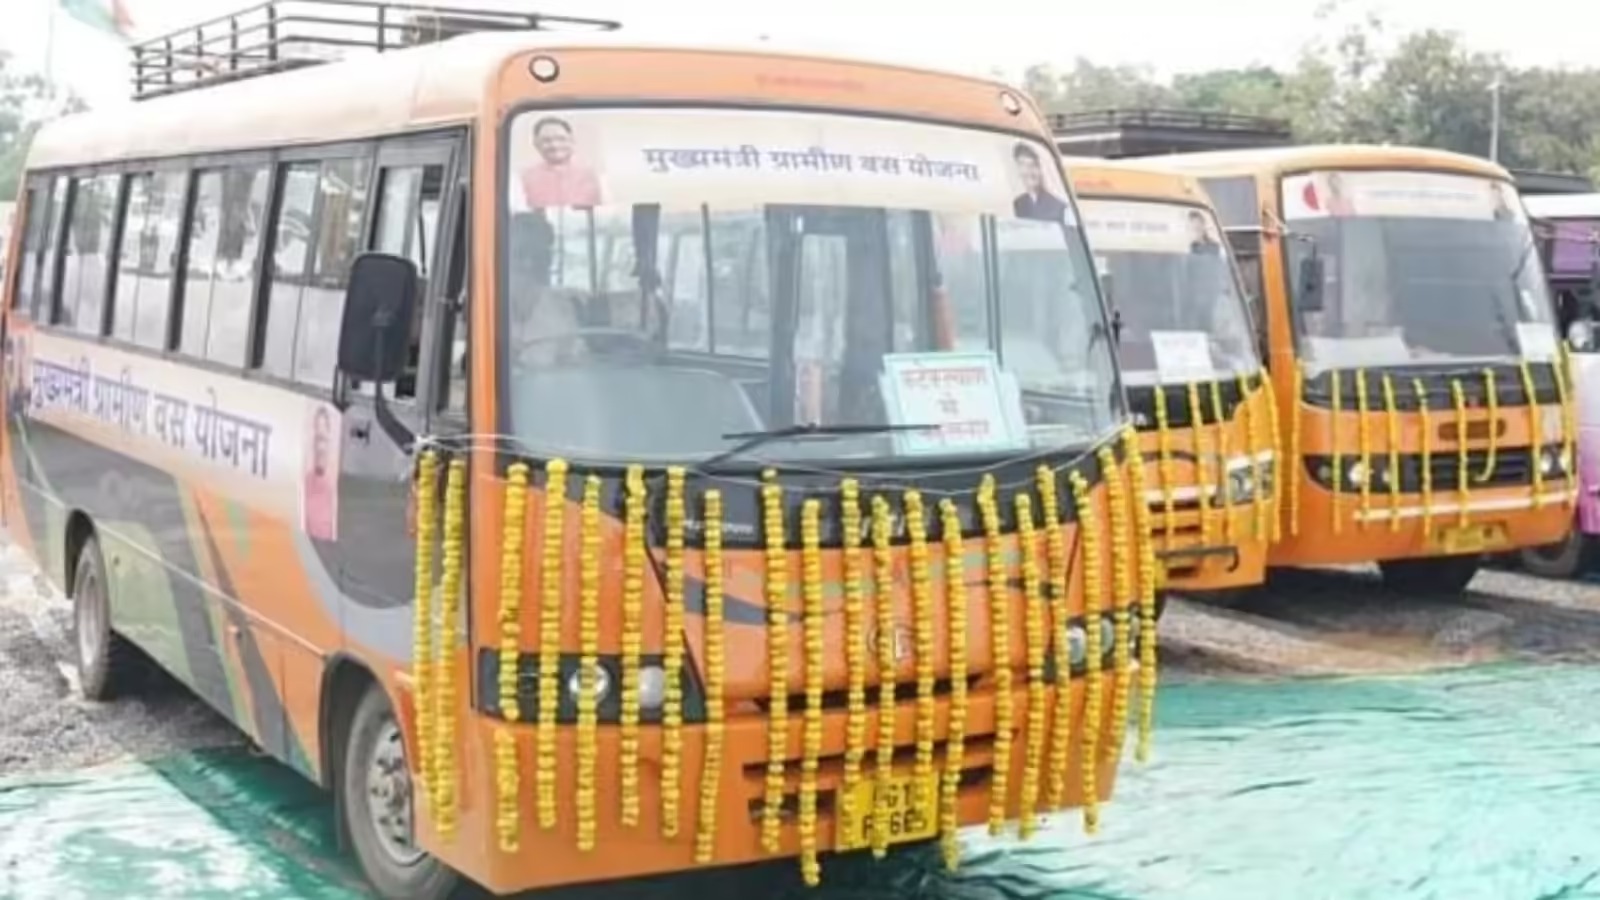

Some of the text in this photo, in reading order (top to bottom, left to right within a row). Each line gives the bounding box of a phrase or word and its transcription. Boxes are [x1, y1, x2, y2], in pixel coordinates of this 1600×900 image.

[643, 144, 760, 173] मुख्यमंत्री
[769, 147, 852, 172] ग्रामीण
[907, 152, 981, 181] योजना
[193, 386, 272, 479] योजना
